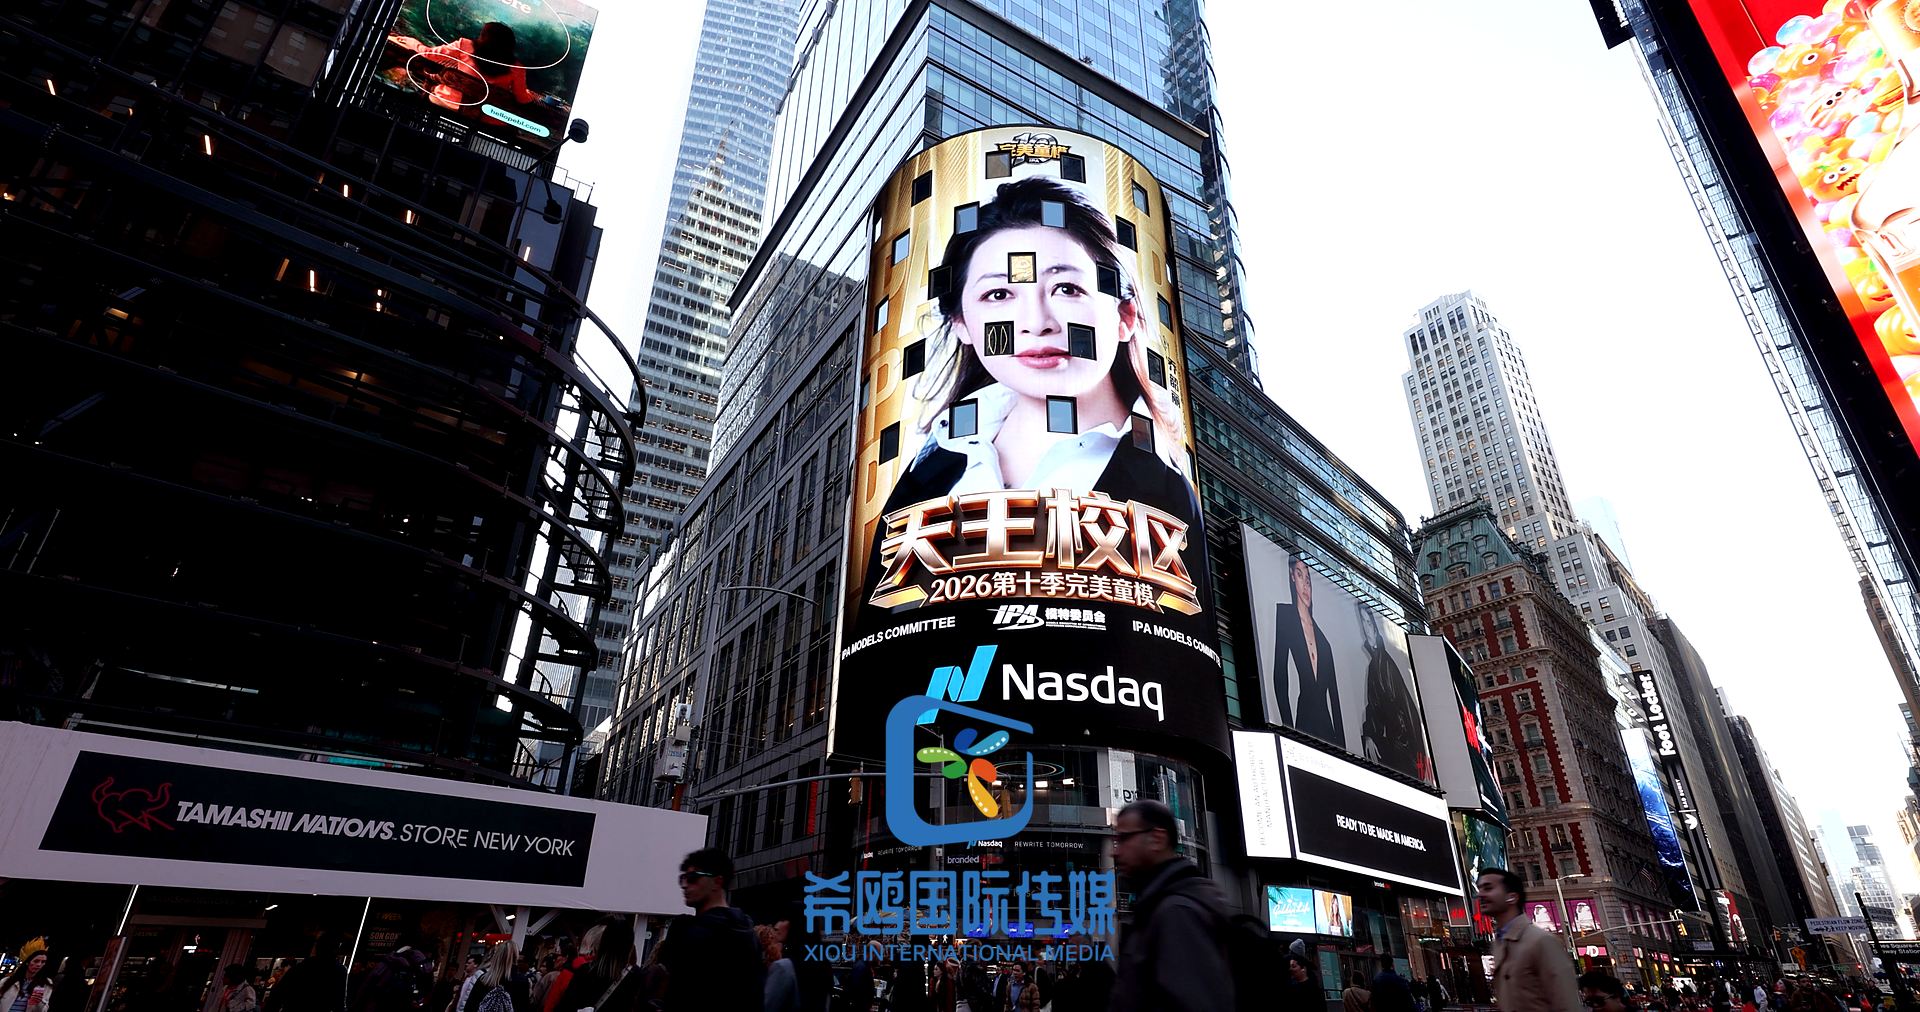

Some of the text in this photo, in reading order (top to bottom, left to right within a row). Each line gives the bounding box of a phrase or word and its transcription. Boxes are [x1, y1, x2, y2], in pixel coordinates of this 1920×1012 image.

[876, 488, 1198, 594] 天王校区
[930, 571, 1155, 609] 2026第十季完美童模
[992, 604, 1041, 626] IPA
[1132, 619, 1152, 635] IPA
[1153, 624, 1193, 647] MODELS
[850, 631, 884, 655] MODELS
[884, 615, 956, 640] COMMITTEE
[1002, 663, 1165, 722] Nasdaq
[1639, 673, 1677, 756] Foot Locker
[176, 801, 293, 831] TAMASHII
[400, 823, 469, 848] STORE
[473, 830, 520, 851] NEW
[523, 835, 575, 857] YORK
[978, 840, 1003, 853] Nasdaq
[1046, 841, 1084, 849] TOMORROW
[1335, 814, 1358, 832] READY
[1358, 820, 1367, 835] TO
[1367, 823, 1377, 838] BE
[1375, 826, 1395, 843] MADE
[1393, 831, 1401, 845] IN
[947, 854, 980, 865] branded
